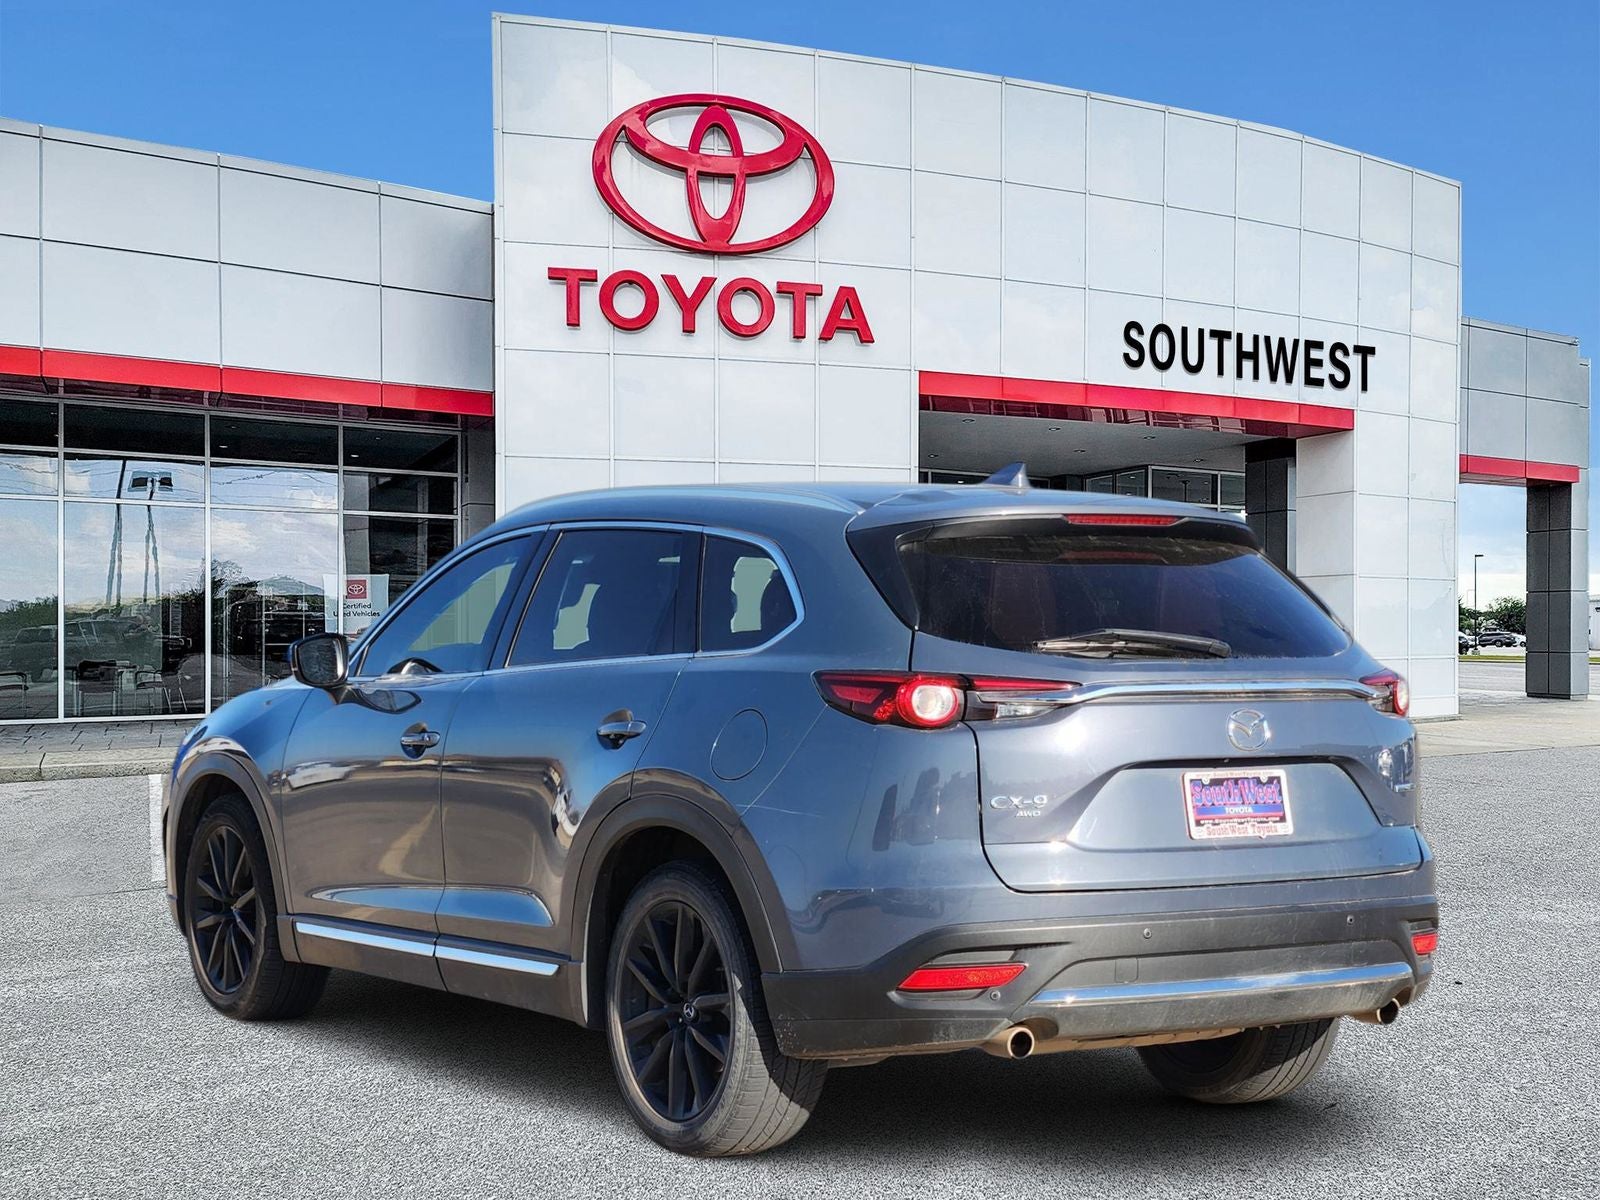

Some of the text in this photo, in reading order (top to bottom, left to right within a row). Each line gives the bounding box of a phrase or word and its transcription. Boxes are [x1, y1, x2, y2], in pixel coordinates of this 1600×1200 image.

[548, 267, 875, 344] TOYOTA
[1123, 320, 1376, 392] SOUTHWEST
[990, 794, 1048, 809] CX-9
[1225, 806, 1253, 814] TOYOTA
[1251, 824, 1279, 836] Toyota
